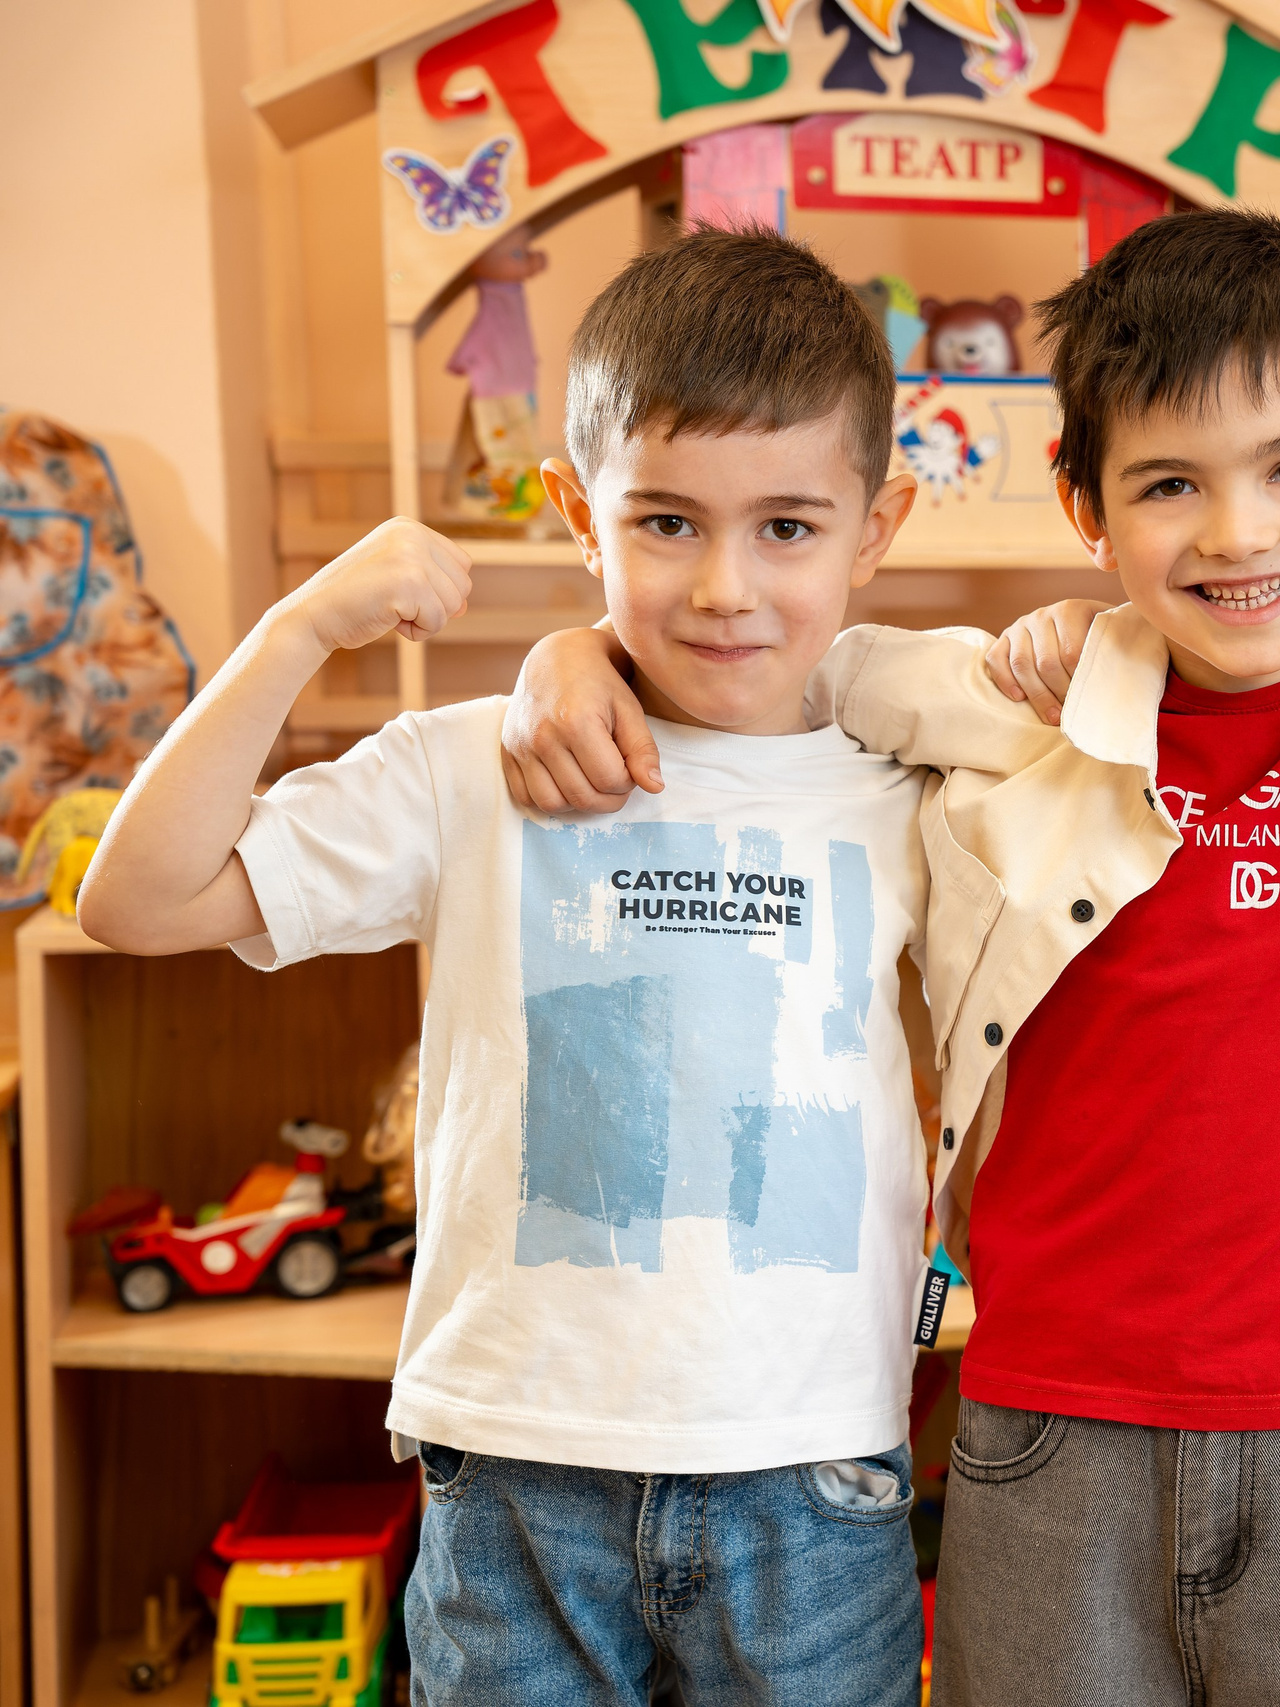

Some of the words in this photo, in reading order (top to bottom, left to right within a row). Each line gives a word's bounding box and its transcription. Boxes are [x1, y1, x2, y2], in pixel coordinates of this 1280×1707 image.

[850, 135, 1024, 183] ТЕАТР
[611, 869, 716, 892] CATCH
[726, 872, 806, 899] YOUR
[1230, 861, 1280, 909] DG
[619, 898, 802, 926] HURRICANE
[659, 925, 698, 934] Stronger
[700, 926, 720, 934] Than
[722, 927, 741, 935] Your
[743, 928, 776, 936] Excuses
[920, 1276, 946, 1341] GULLIVER
